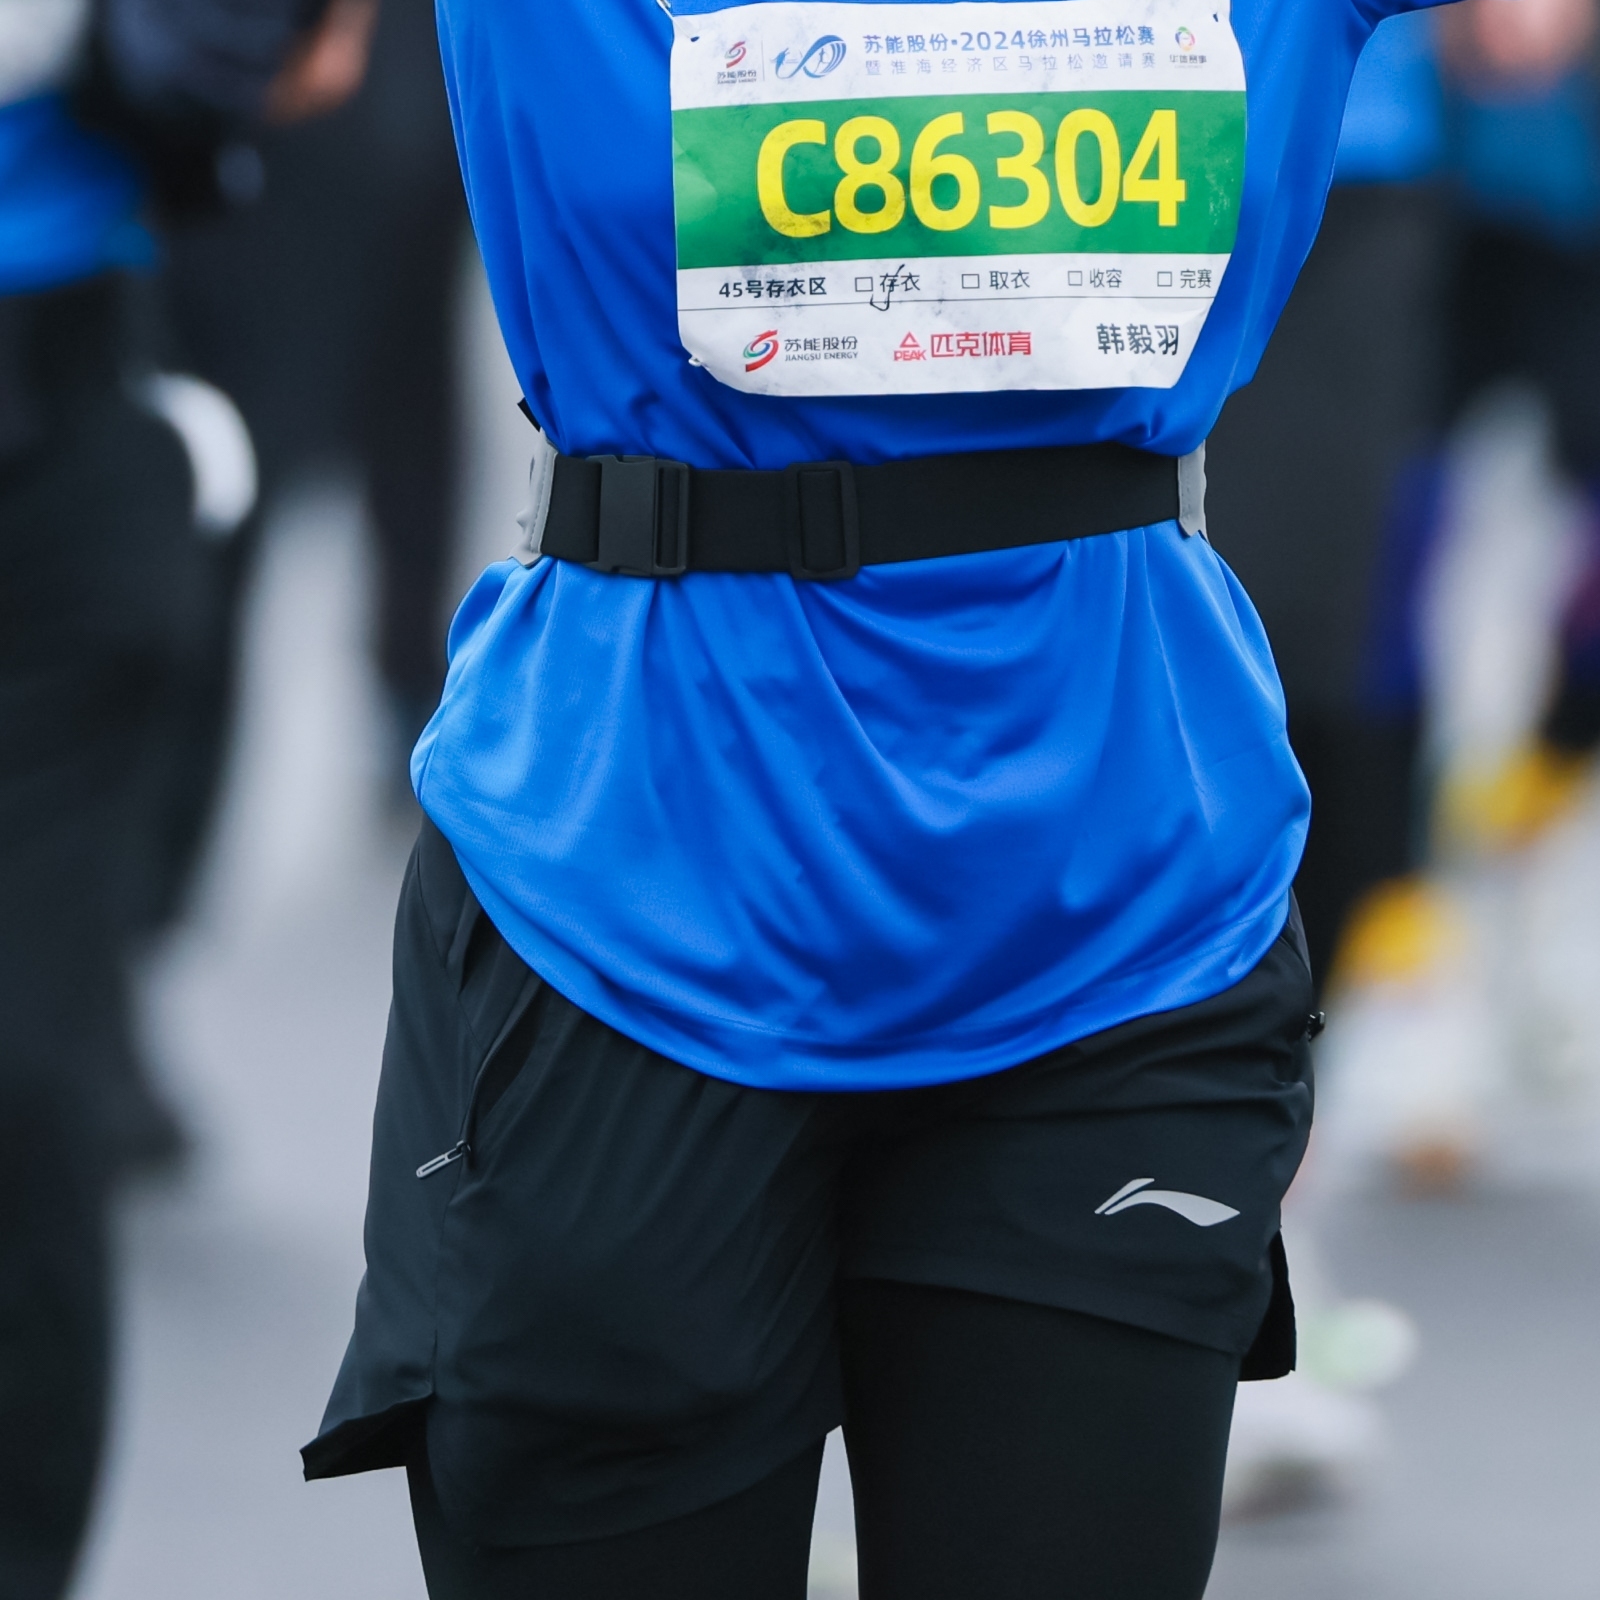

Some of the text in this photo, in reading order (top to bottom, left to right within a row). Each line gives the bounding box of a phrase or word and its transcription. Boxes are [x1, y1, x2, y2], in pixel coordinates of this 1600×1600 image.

[756, 108, 1187, 238] C86304
[718, 277, 827, 299] 45号存衣区
[880, 272, 921, 293] 存衣
[989, 269, 1031, 290] 取衣
[1089, 268, 1123, 289] 收容
[1180, 268, 1212, 289] 完赛
[784, 335, 859, 352] 苏能股份
[930, 331, 1032, 359] 匹克体育
[1096, 323, 1180, 356] 韩毅羽
[784, 351, 859, 362] JIANGSU ENERGY
[893, 350, 927, 362] PEAK
